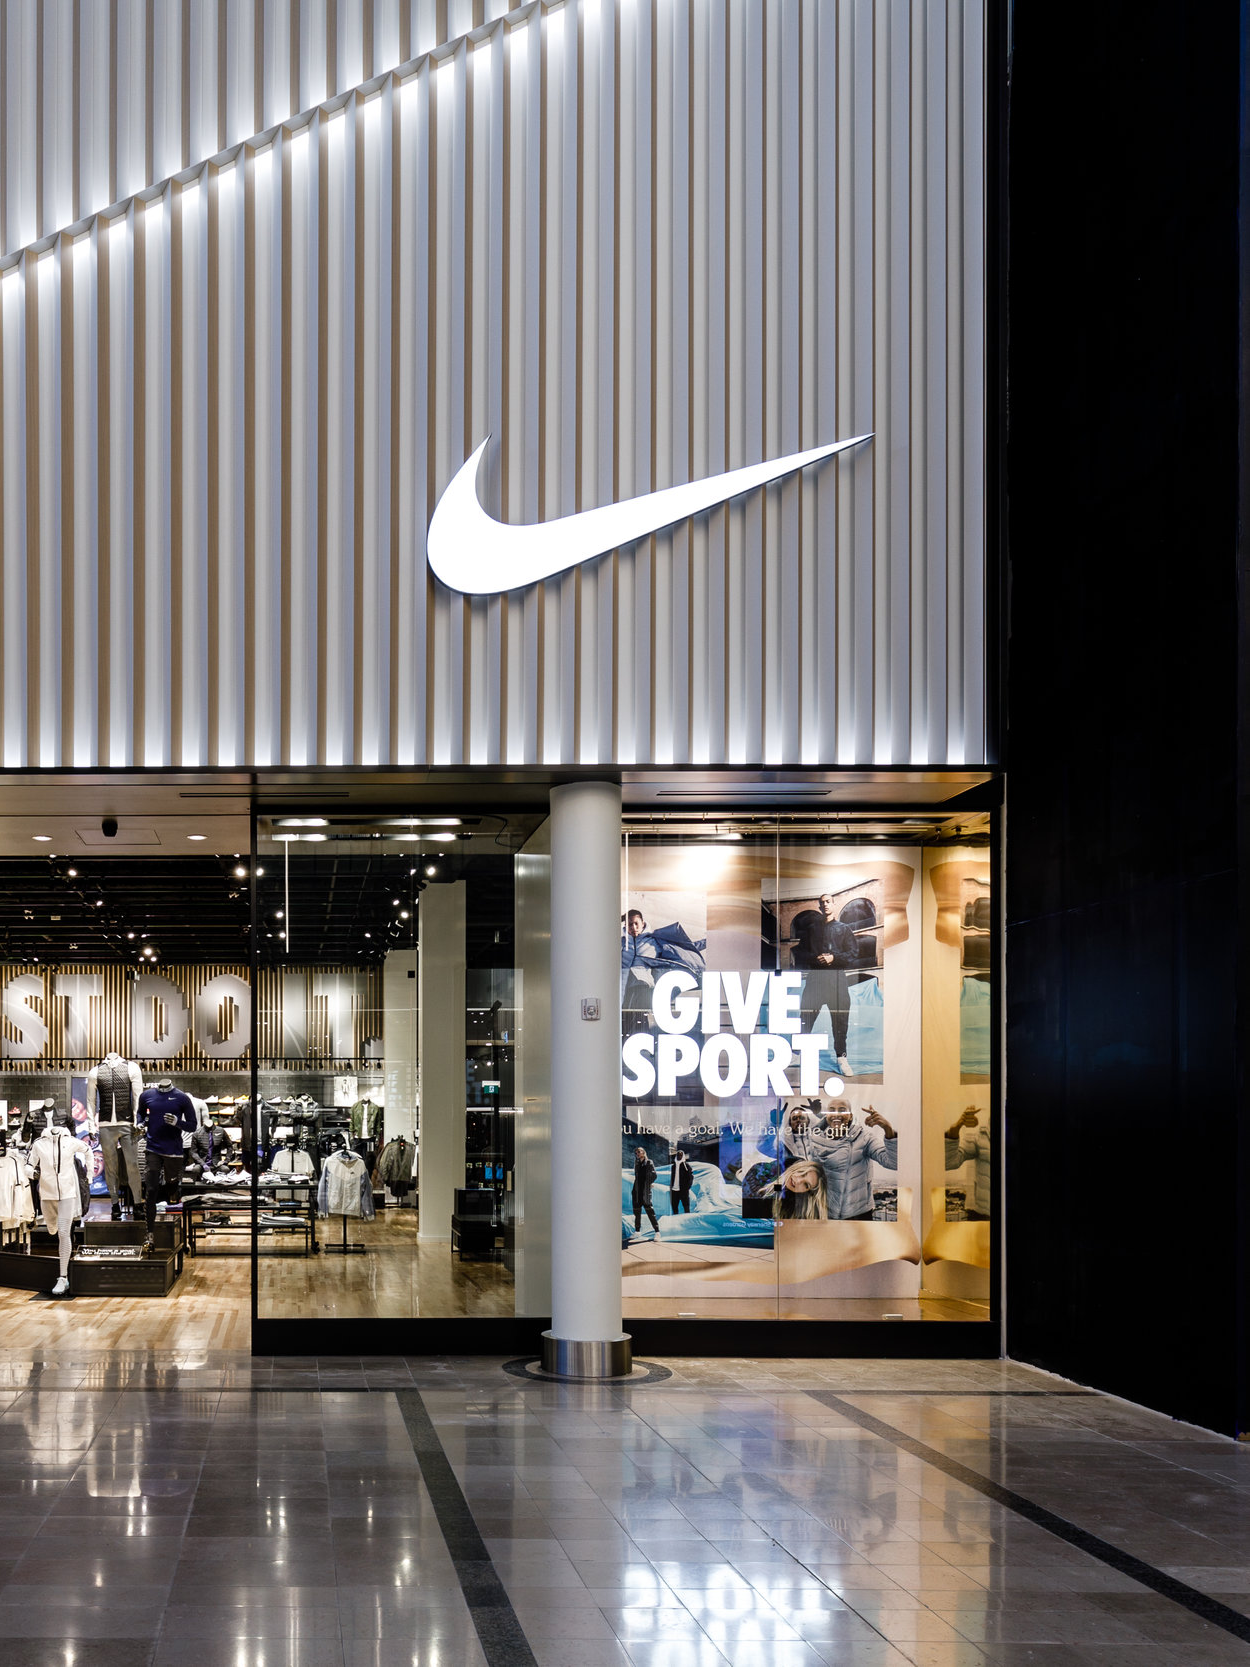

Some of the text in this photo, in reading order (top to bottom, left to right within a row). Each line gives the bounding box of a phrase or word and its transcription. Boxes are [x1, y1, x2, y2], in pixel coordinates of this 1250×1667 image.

[130, 973, 252, 1059] DO
[651, 969, 803, 1035] GIVE
[621, 1032, 846, 1098] SPORT.
[637, 1121, 671, 1135] have
[675, 1124, 684, 1135] a
[688, 1121, 724, 1138] goal.
[729, 1121, 753, 1136] We
[758, 1121, 793, 1136] have
[797, 1122, 823, 1137] the
[825, 1123, 854, 1140] gift.
